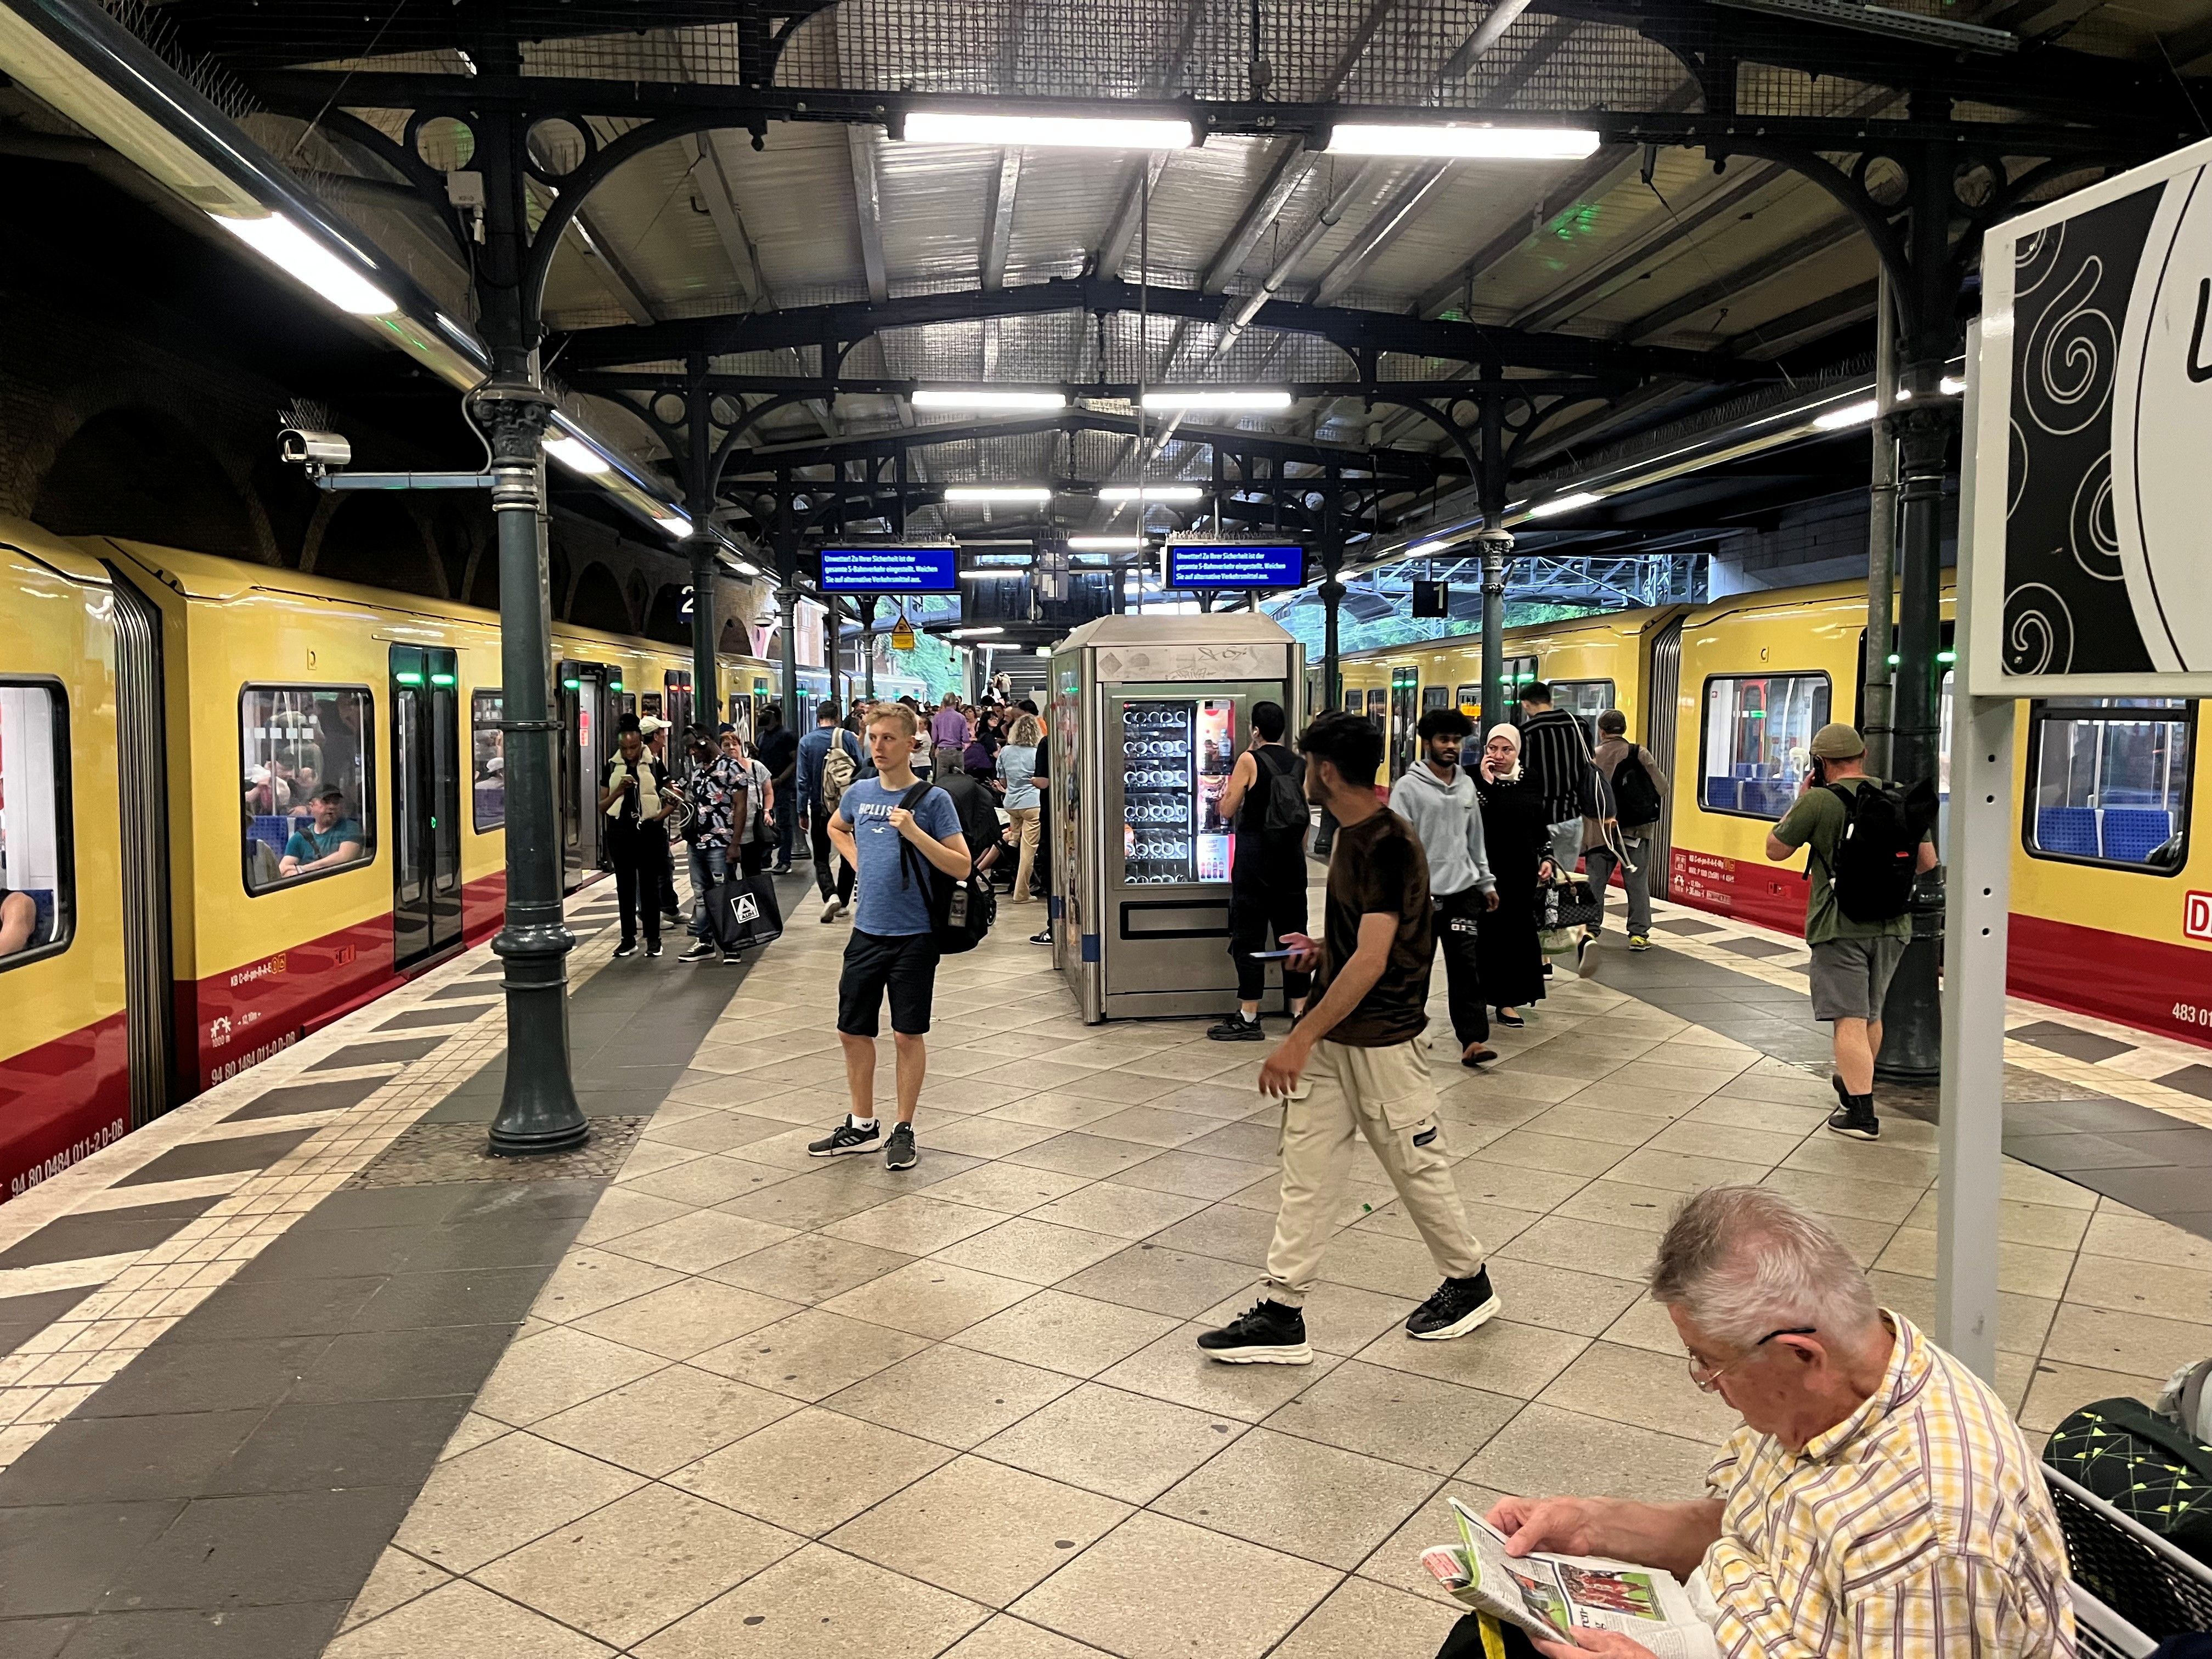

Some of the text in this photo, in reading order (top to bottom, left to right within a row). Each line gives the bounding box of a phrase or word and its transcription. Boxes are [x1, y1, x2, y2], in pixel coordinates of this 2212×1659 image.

[681, 585, 693, 613] 2
[1433, 583, 1444, 609] 1
[2172, 1002, 2195, 1023] 483
[211, 1066, 223, 1086] 94
[225, 1060, 236, 1080] 80
[12, 1118, 123, 1199] 94 80 0484 011-2 D-DB
